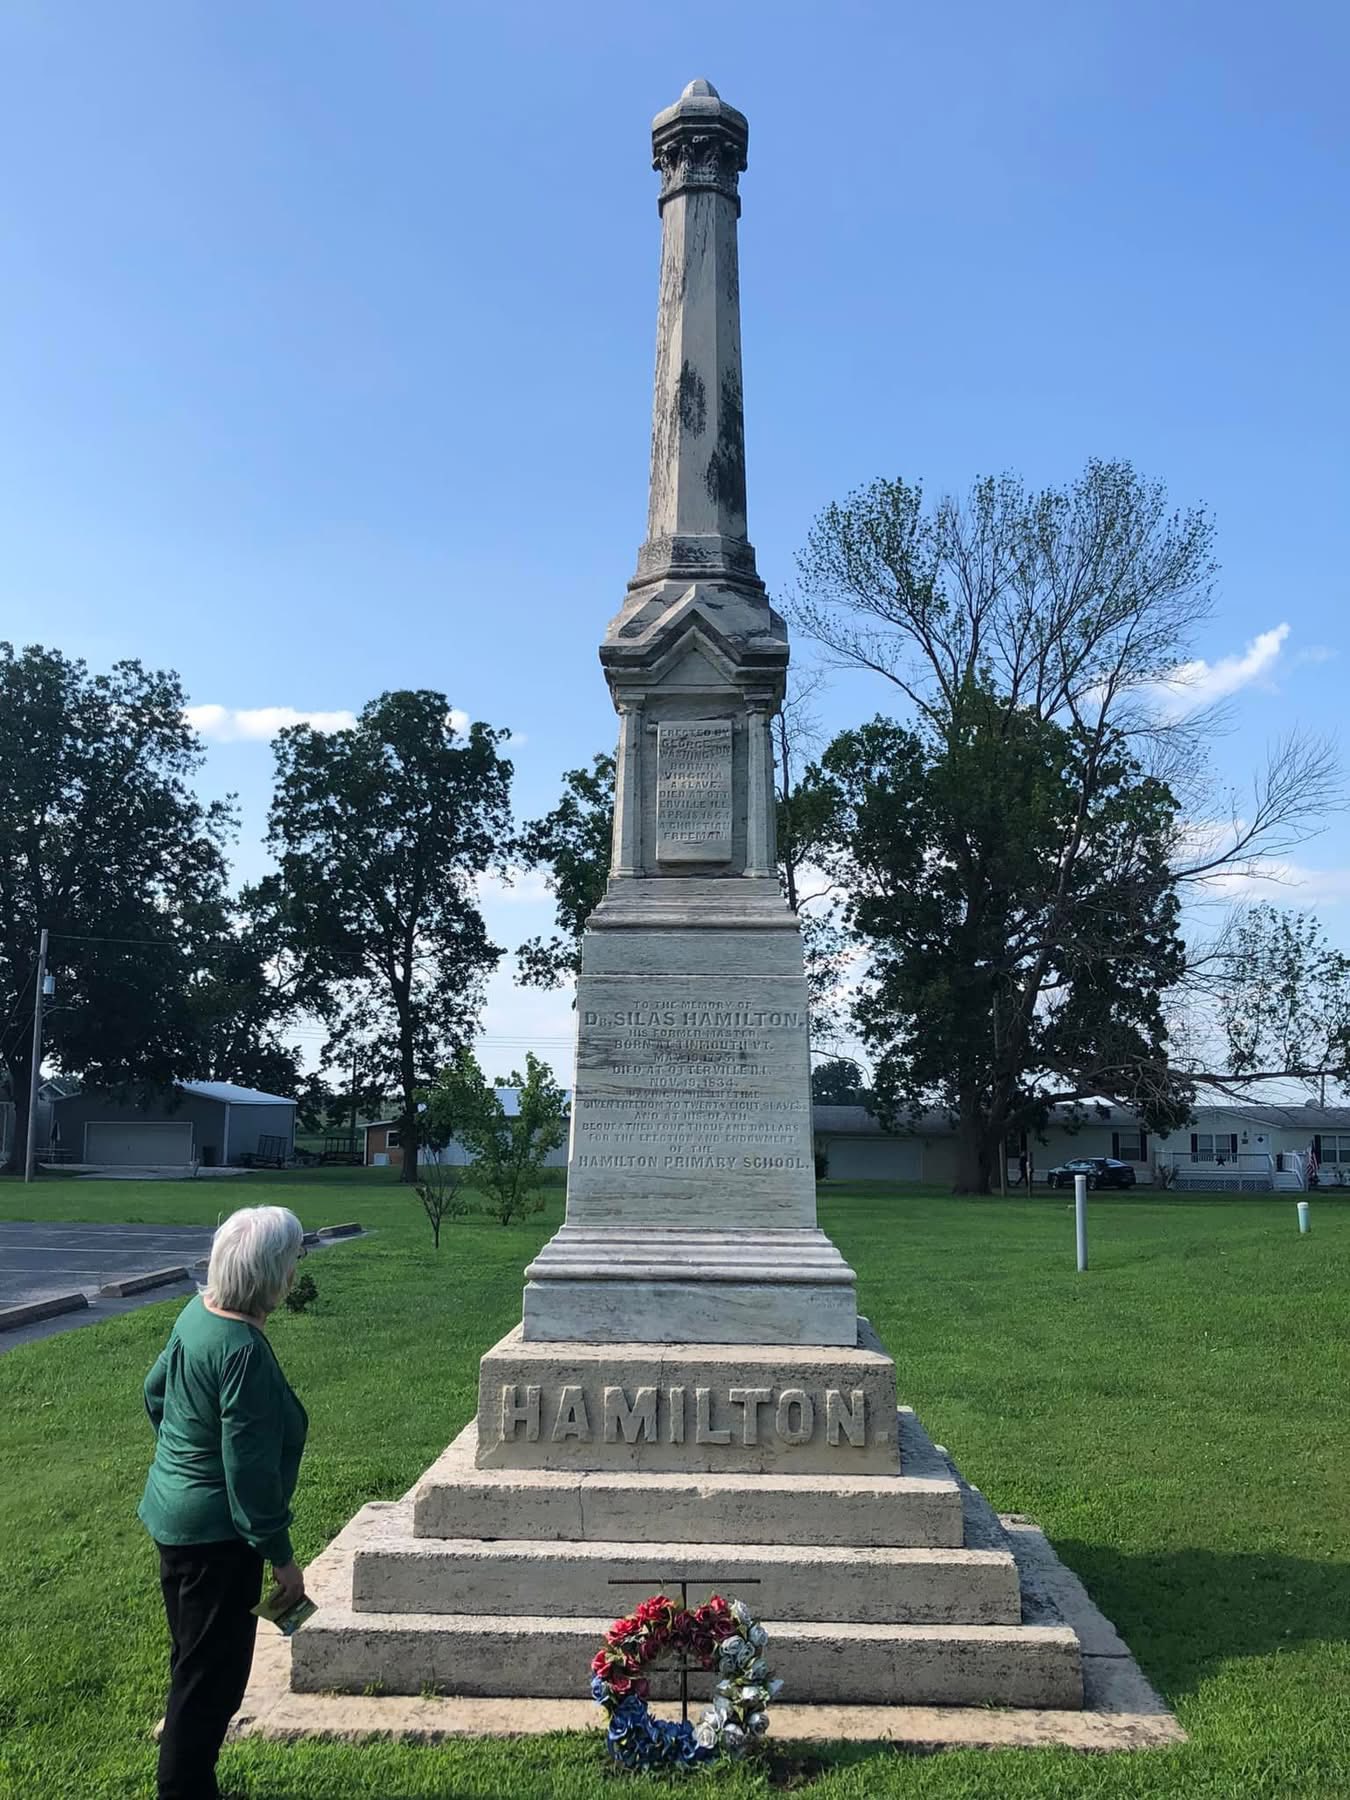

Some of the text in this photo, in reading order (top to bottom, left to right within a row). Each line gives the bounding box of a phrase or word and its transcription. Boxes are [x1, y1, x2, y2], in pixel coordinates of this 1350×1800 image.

[662, 738, 711, 748] GEORGE
[671, 762, 719, 770] BORN IN
[659, 790, 685, 798] DIED
[660, 800, 706, 809] ERVILLE
[633, 1000, 752, 1009] TO THE MEMORY OF
[614, 1011, 675, 1027] SILAS
[629, 1029, 648, 1037] HIS
[654, 1029, 700, 1037] FORMER
[615, 1040, 651, 1049] BORN
[613, 1065, 641, 1074] DIED
[648, 1065, 662, 1074] AT
[667, 1065, 747, 1075] OTTERVILLE
[668, 1101, 681, 1109] TO
[634, 1112, 659, 1120] AND
[664, 1112, 680, 1120] AT
[751, 1123, 799, 1132] DOLLARS
[589, 1134, 609, 1142] FOR
[616, 1134, 634, 1142] THE
[669, 1145, 712, 1154] OF THE
[579, 1155, 657, 1168] HAMILTON
[664, 1156, 736, 1168] PRIMARY
